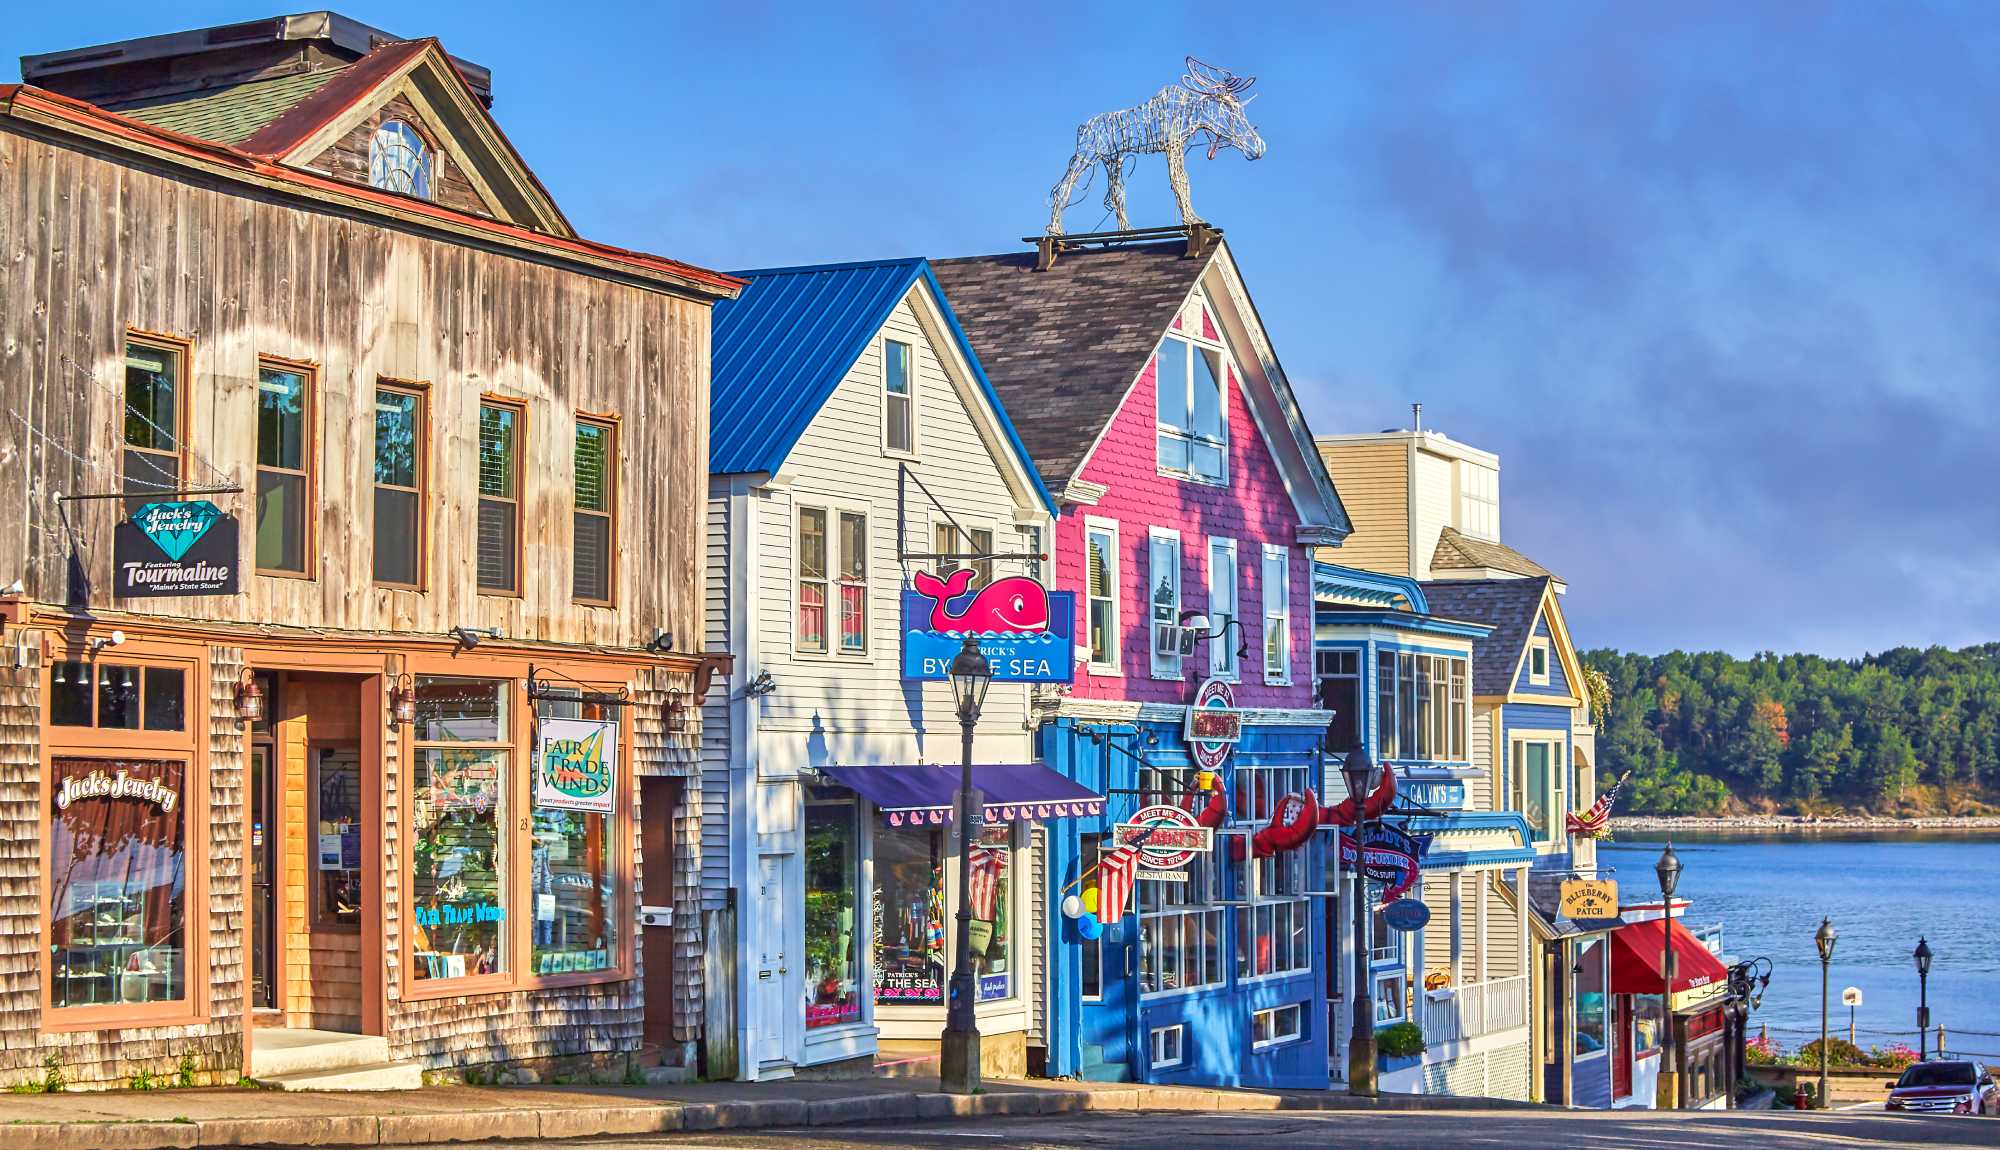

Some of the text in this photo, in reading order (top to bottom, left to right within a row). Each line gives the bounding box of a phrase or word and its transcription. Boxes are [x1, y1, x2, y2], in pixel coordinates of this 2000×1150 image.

[146, 508, 192, 523] Jack's
[146, 520, 204, 534] Jewelry
[145, 561, 182, 569] Featuring
[123, 561, 229, 587] Tourmaline
[960, 647, 1016, 656] RICK'S
[923, 658, 951, 675] BY
[1010, 659, 1051, 677] SEA
[1204, 683, 1217, 699] MEET
[544, 737, 584, 755] FAIR
[546, 755, 609, 775] TRADE
[1199, 750, 1213, 766] SINCE
[541, 772, 609, 793] WINDS
[57, 769, 177, 813] Jack's Jewelry
[1410, 783, 1447, 804] GALYN'S
[1140, 809, 1186, 822] MEET ME AT
[1141, 854, 1183, 865] SINCE 1974
[1136, 871, 1186, 880] RESTAURANT
[1566, 888, 1613, 905] BLUEBERRY
[1576, 907, 1603, 916] PATCH
[887, 979, 911, 988] THE
[914, 979, 938, 988] SEA
